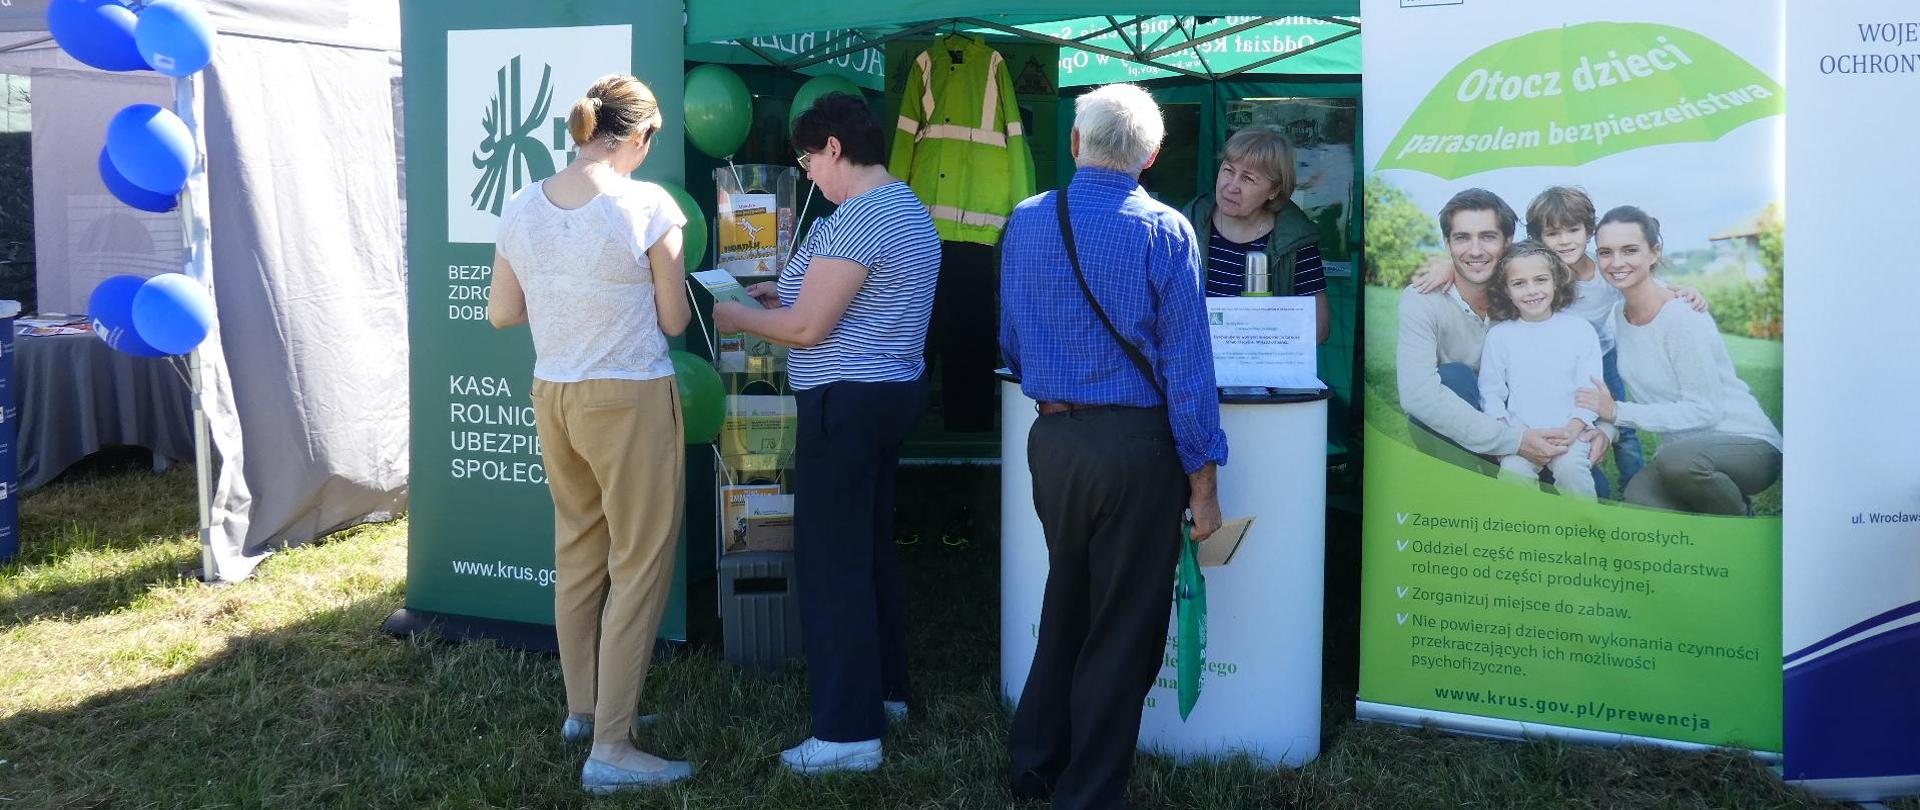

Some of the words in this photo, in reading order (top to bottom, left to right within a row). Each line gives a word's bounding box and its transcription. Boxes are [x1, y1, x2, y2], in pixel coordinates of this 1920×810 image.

[1858, 22, 1920, 46] WOJE
[1456, 67, 1562, 103] Otocz
[1572, 36, 1694, 93] dzieci
[1819, 54, 1920, 74] OCHRON
[1396, 126, 1541, 159] parasolem
[1548, 83, 1773, 145] bezpieczeństwa
[450, 375, 512, 397] KASA
[451, 458, 549, 484] SPOŁEC
[1412, 513, 1479, 532] Zapewnij
[1483, 517, 1550, 534] dzieciom
[1555, 523, 1606, 543] opiekę
[1610, 526, 1695, 547] dorosłych.
[1851, 512, 1866, 524] ul.
[1412, 539, 1469, 558] Oddziel
[1472, 544, 1514, 563] część
[1519, 548, 1608, 572] mieszkalną
[1612, 557, 1729, 578] gospodarstwa
[1411, 561, 1468, 580] rolnego
[1472, 565, 1491, 580] od
[1495, 567, 1543, 585] części
[1547, 570, 1656, 595] produkcyjnej.
[1412, 587, 1489, 607] Zorganizuj
[1494, 595, 1550, 612] miejsce
[1554, 599, 1574, 615] do
[1577, 602, 1632, 620] zabaw.
[1411, 634, 1538, 659] przekraczających
[1542, 644, 1565, 660] ich
[1569, 649, 1657, 671] możliwości
[1412, 613, 1436, 629] Nie
[1440, 617, 1511, 637] powierzaj
[1515, 624, 1584, 644] dzieciom
[1589, 632, 1672, 652] wykonania
[1677, 640, 1760, 661] czynności
[1411, 653, 1527, 677] psychofizyczne.
[1435, 687, 1710, 731] www.krus.gov.pl/prewencja
